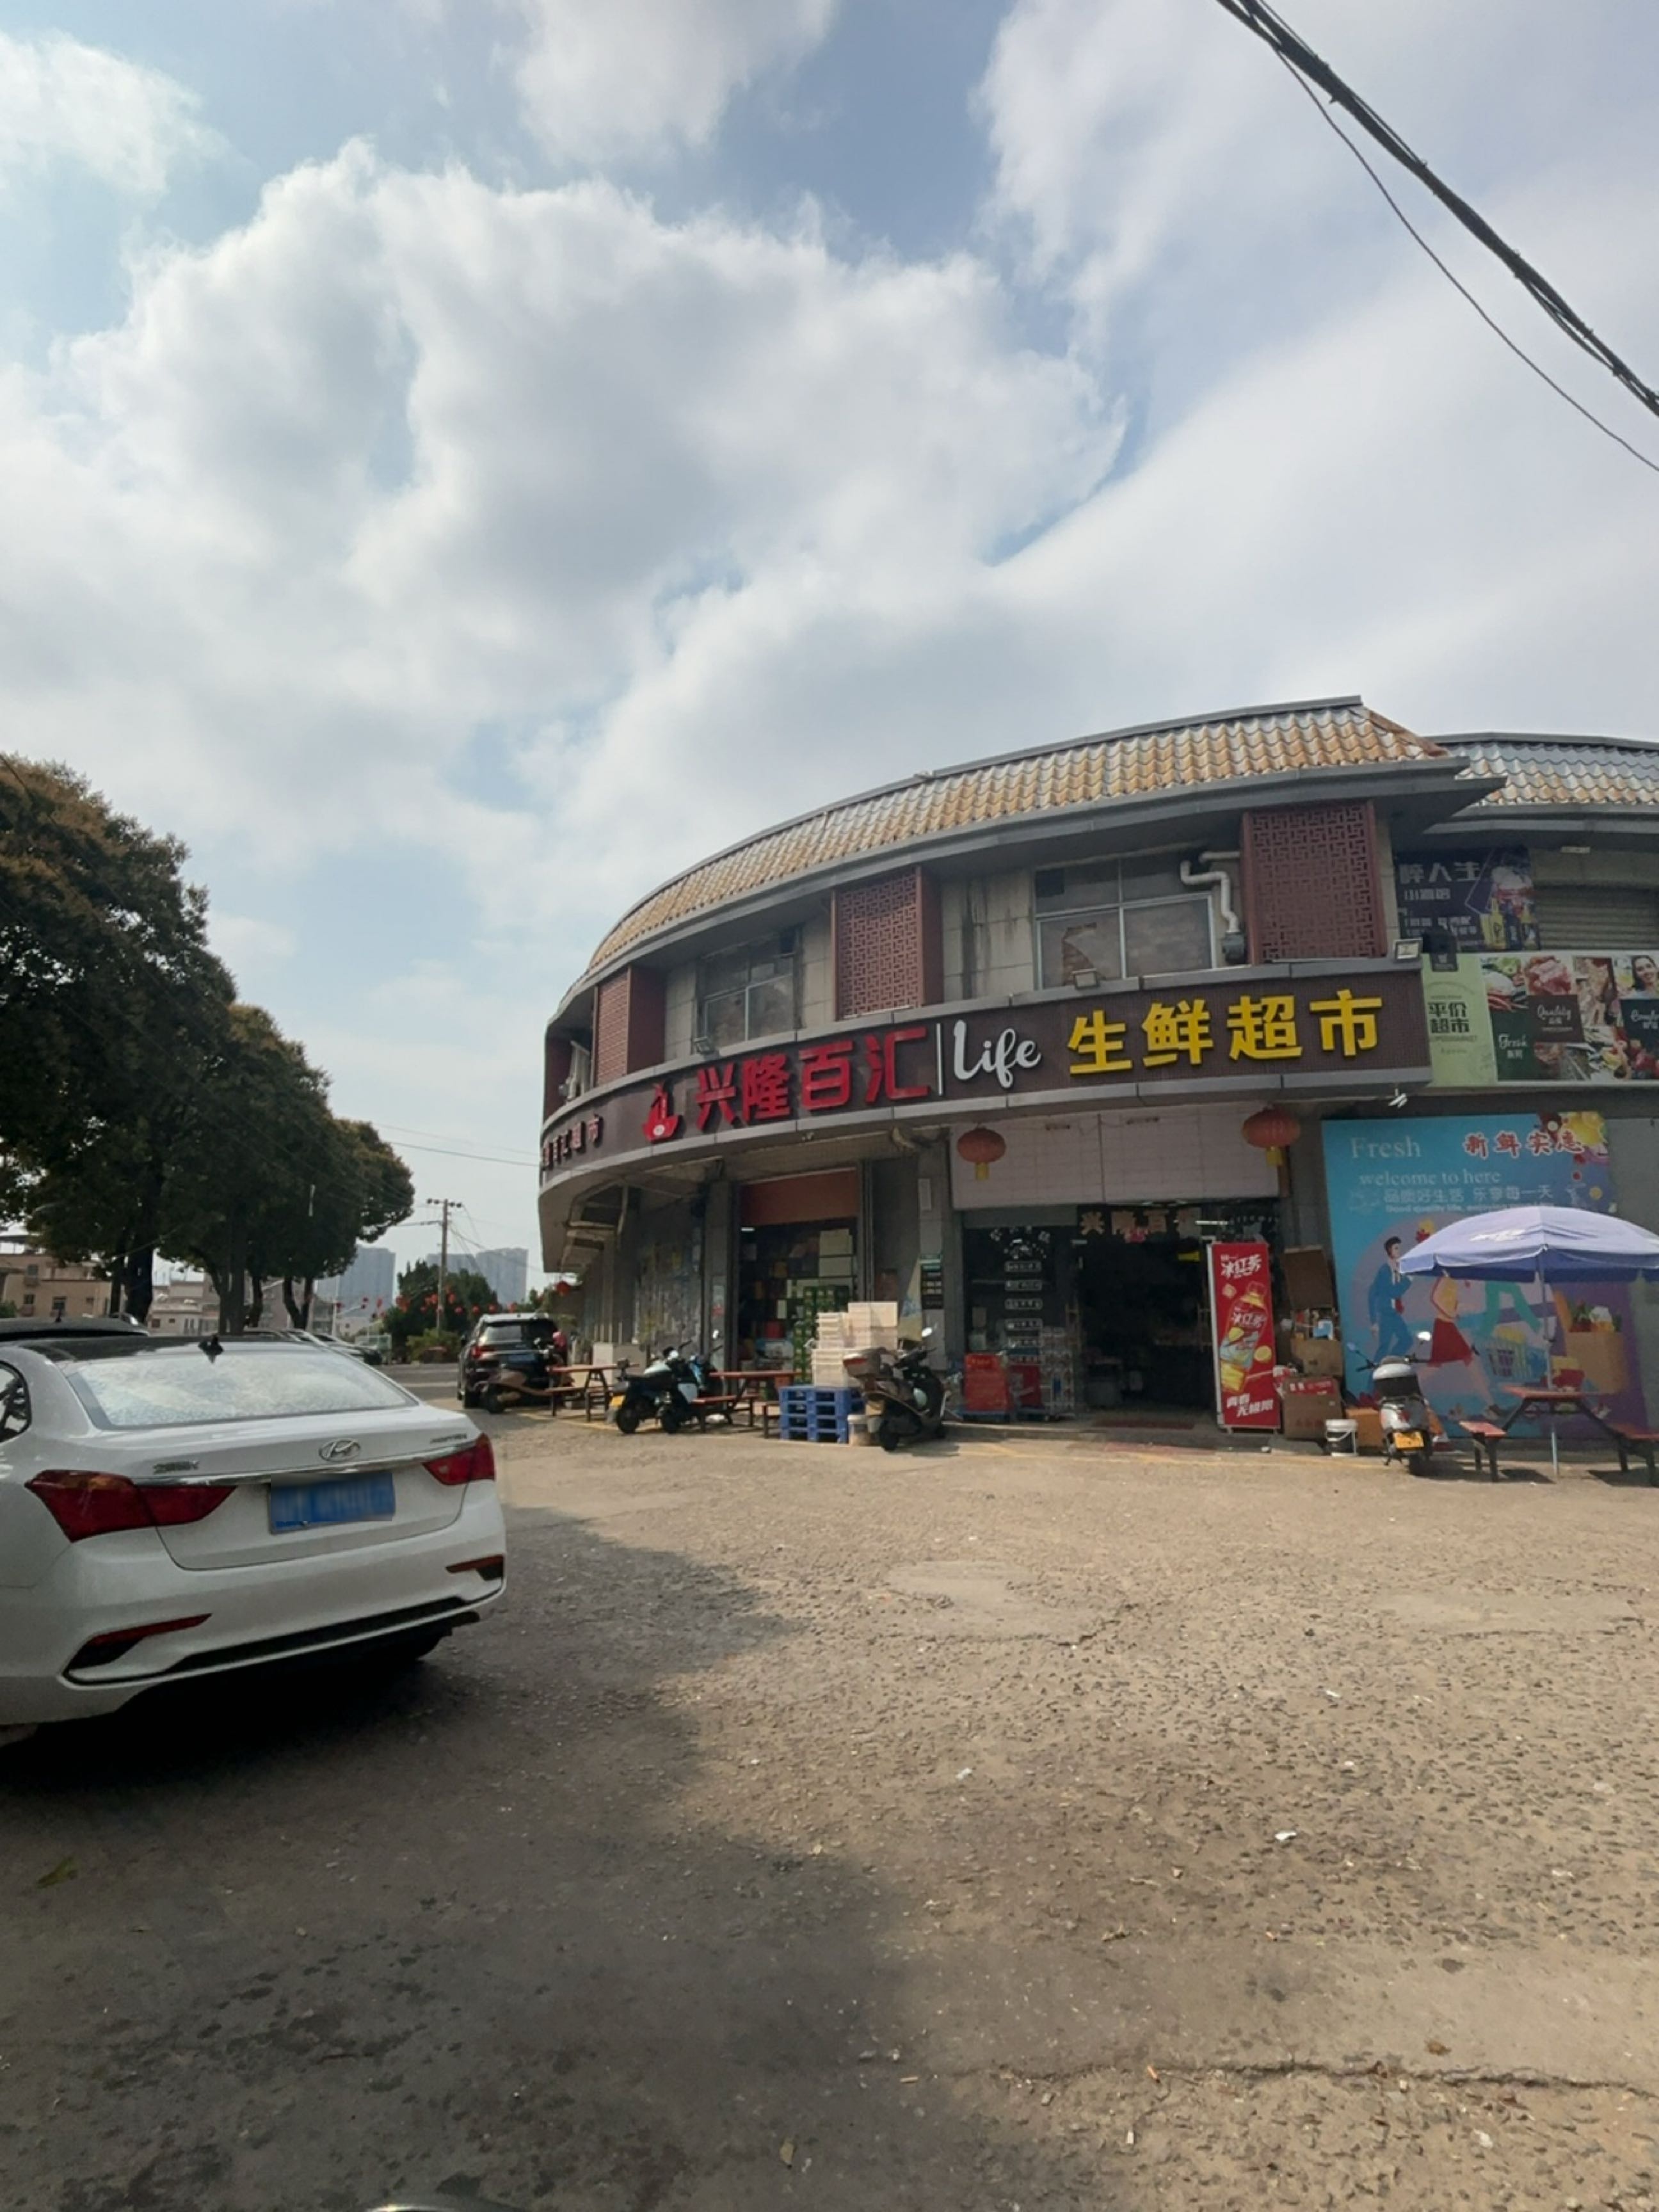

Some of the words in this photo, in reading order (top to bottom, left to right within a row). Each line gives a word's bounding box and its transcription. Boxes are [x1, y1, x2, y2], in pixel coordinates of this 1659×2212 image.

[1428, 1002, 1466, 1017] 平价
[1537, 1004, 1572, 1020] Quality
[1430, 1018, 1470, 1033] 超市
[696, 1027, 931, 1130] 兴隆百汇
[953, 1020, 1041, 1088] Life
[1068, 989, 1382, 1075] 生鲜超市
[1349, 1135, 1422, 1159] Fresh
[1463, 1130, 1584, 1159] 新鲜实惠
[1359, 1169, 1438, 1185] welcome
[1442, 1171, 1459, 1185] to
[1463, 1169, 1502, 1185] here
[1383, 1187, 1465, 1203] 品质好生活
[1473, 1185, 1555, 1202] 乐享每一天
[1221, 1254, 1262, 1278] 冰红茶
